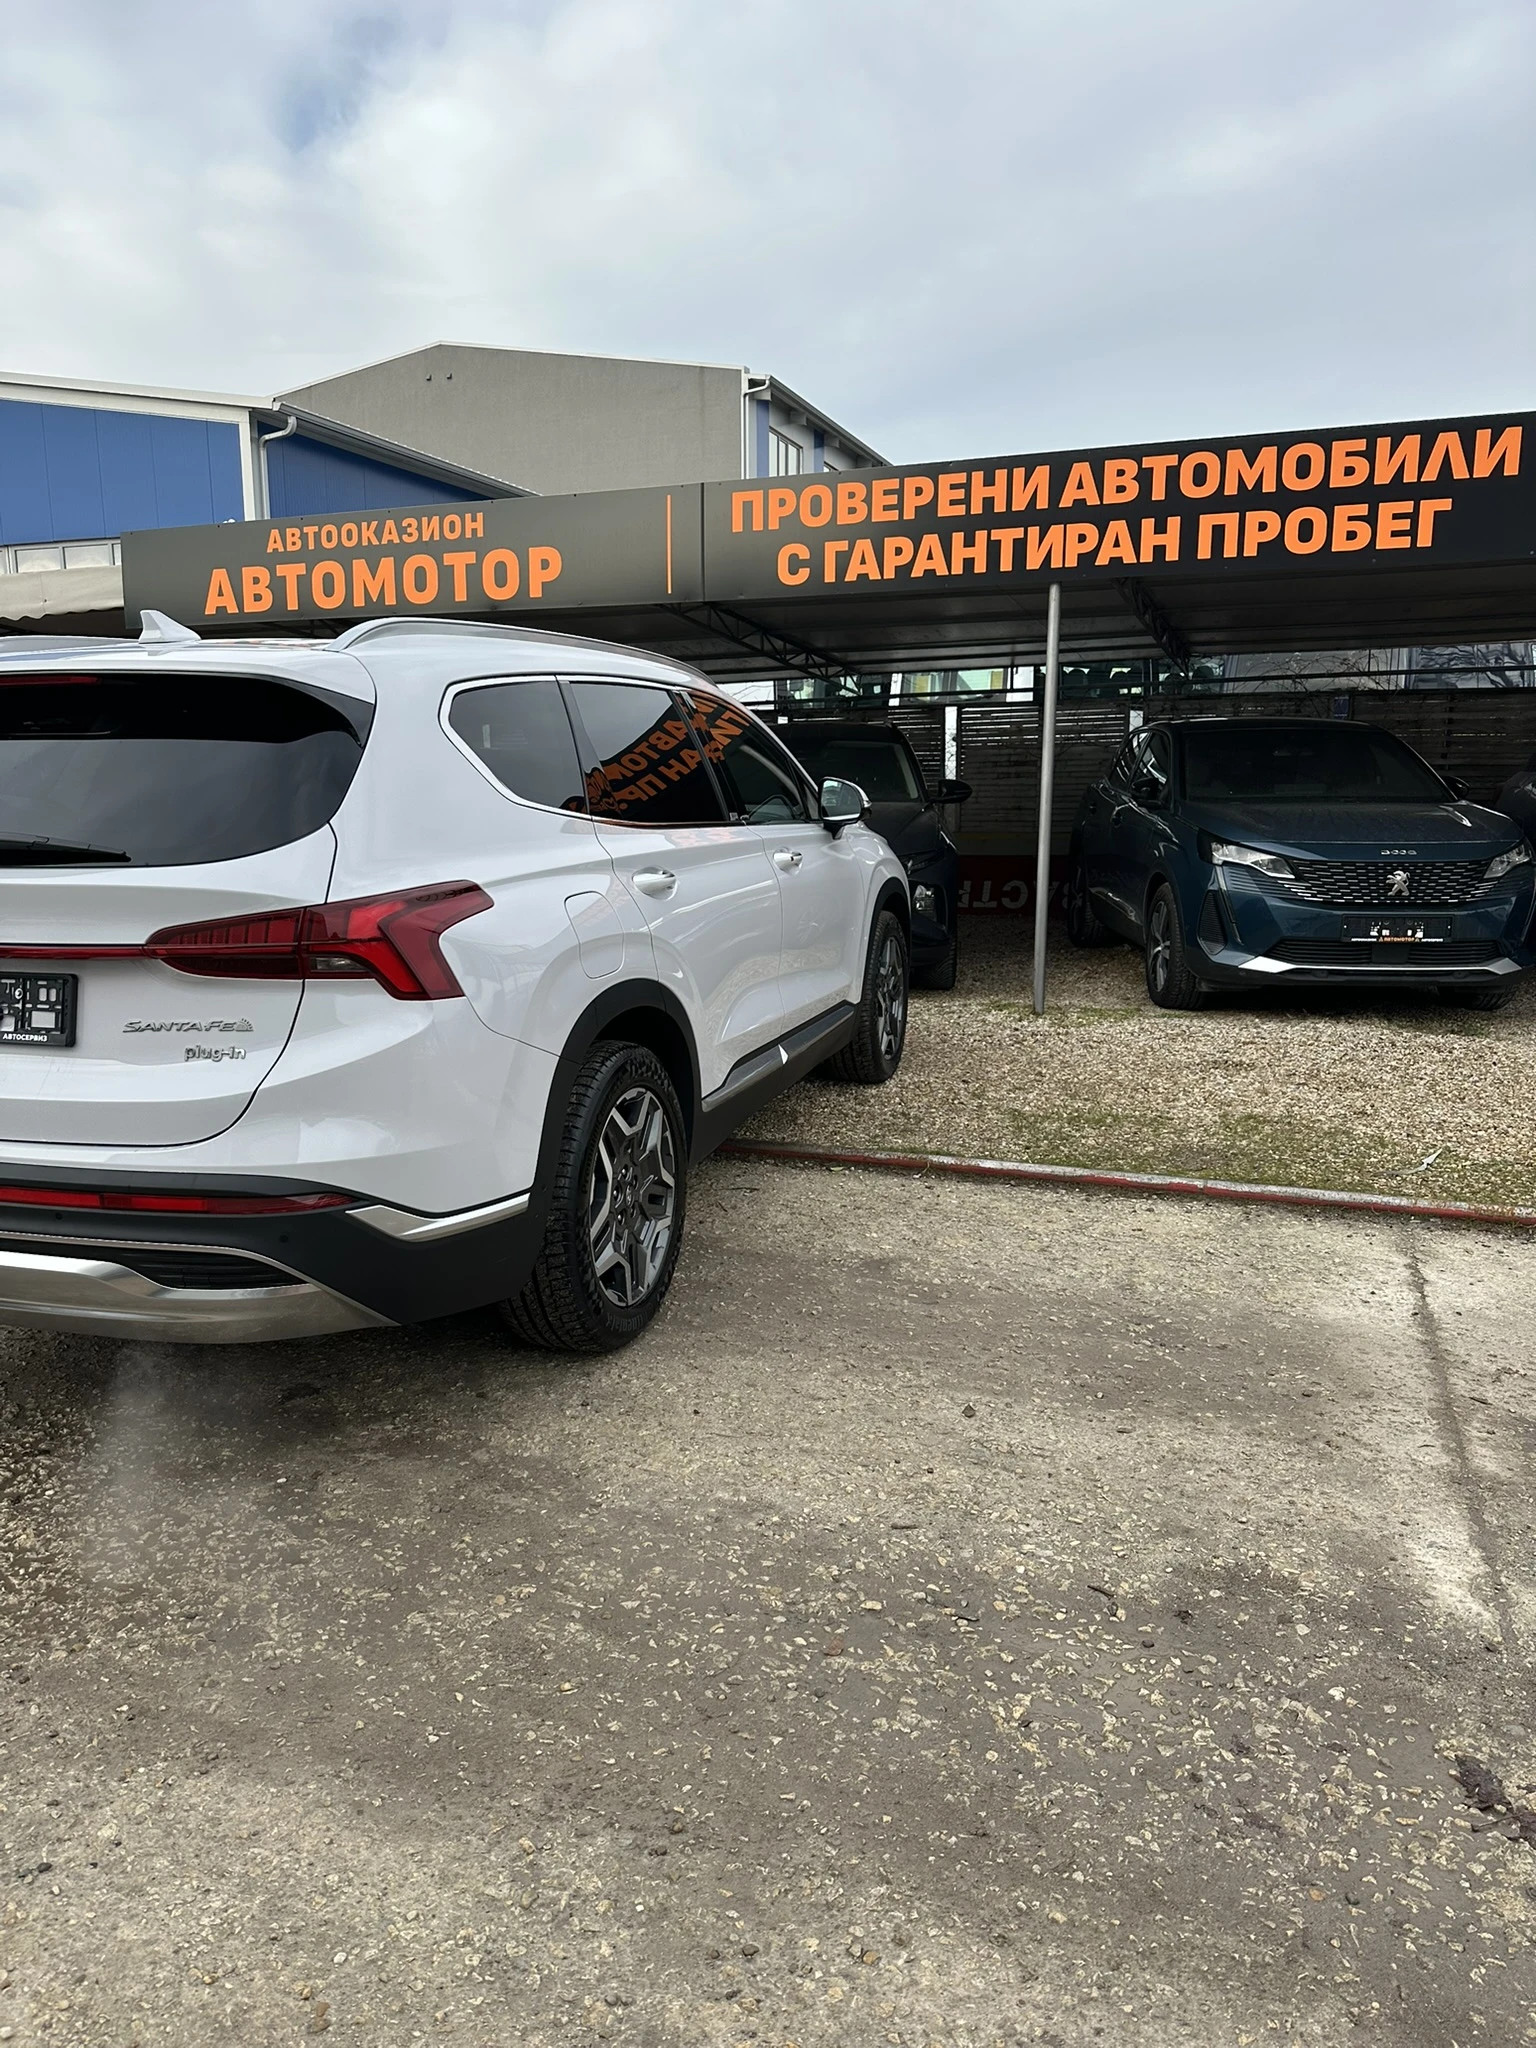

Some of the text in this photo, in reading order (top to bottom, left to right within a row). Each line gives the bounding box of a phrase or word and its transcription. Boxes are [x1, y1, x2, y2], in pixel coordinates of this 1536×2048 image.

[731, 426, 1522, 533] ПРОВЕРЕНИ АВТОМОБИЛИ
[266, 512, 484, 553] АВТООКАЗИОН
[777, 498, 1452, 586] С ГАРАНТИРАН ПРОБЕГ
[204, 546, 562, 615] АВТОМОТОР
[184, 1044, 246, 1062] plug-in
